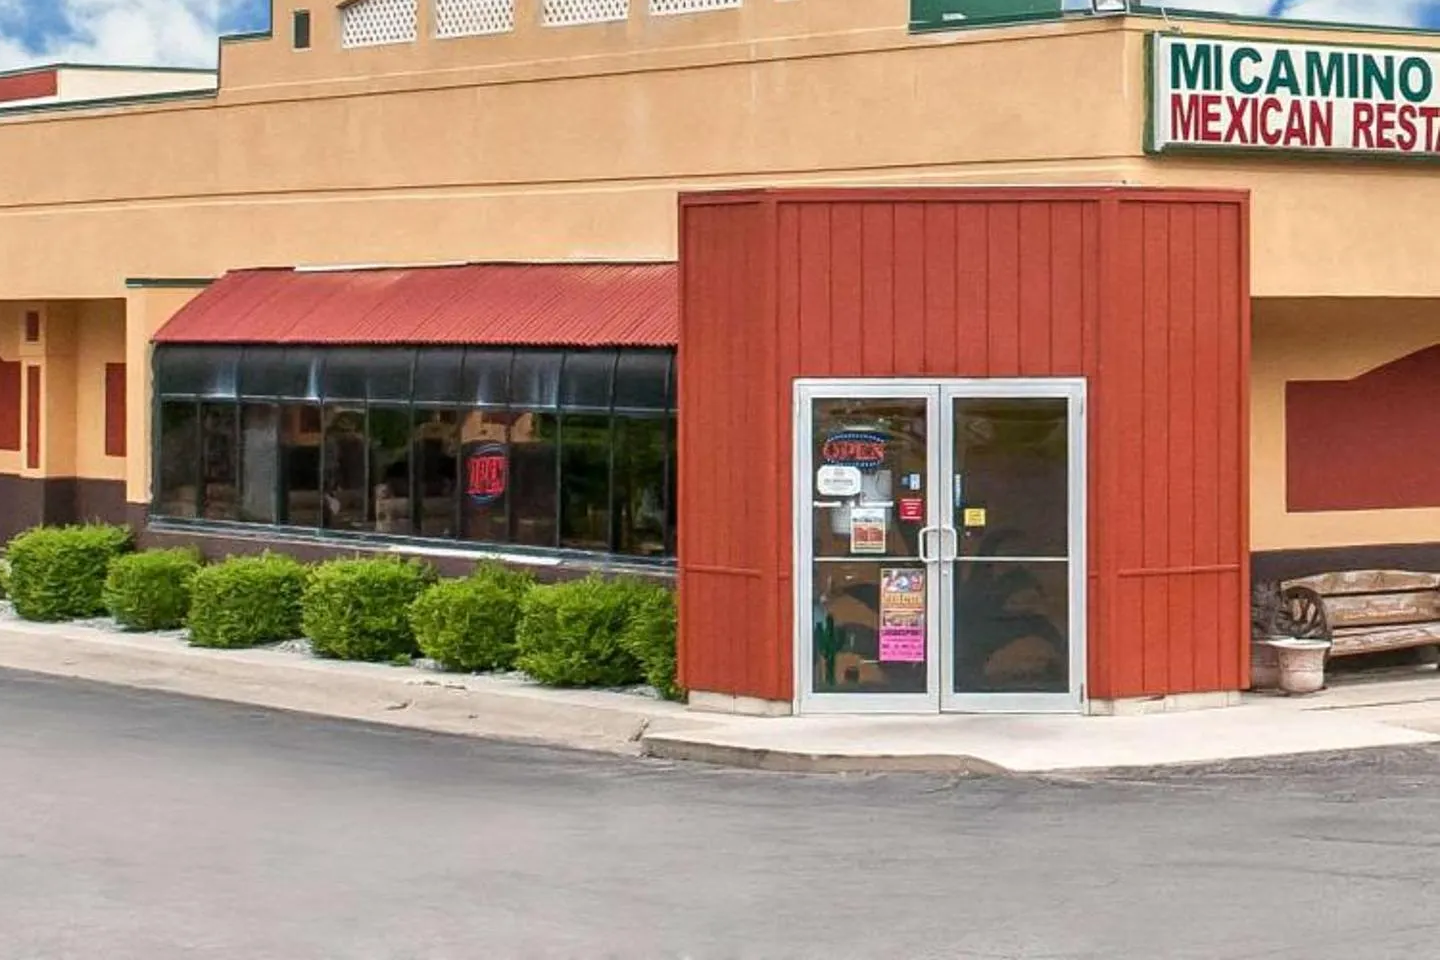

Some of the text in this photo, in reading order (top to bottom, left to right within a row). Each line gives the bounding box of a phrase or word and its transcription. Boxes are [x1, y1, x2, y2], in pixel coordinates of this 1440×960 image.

[1170, 94, 1440, 151] MEXICAN REST
[822, 440, 885, 461] OPEN
